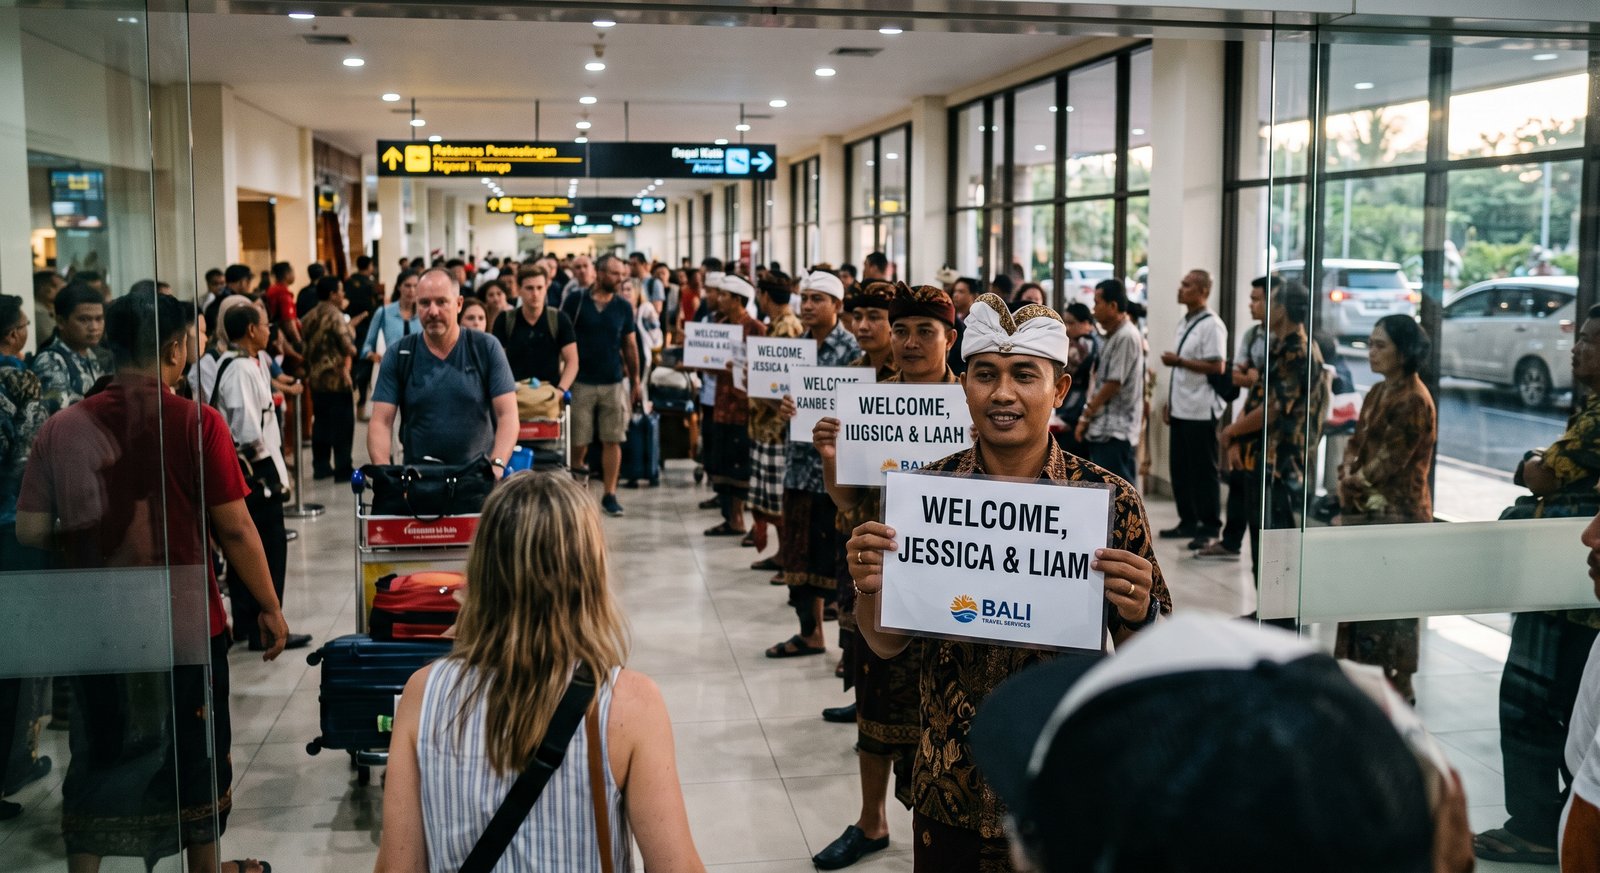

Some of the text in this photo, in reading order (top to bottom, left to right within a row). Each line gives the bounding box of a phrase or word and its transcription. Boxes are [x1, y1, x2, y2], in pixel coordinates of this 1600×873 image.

[752, 361, 782, 373] JESSICA
[859, 396, 950, 419] WELCOME,
[909, 425, 919, 443] &
[922, 495, 1067, 540] WELCOME,
[898, 536, 1089, 580] JESSICA & LIAM
[982, 599, 1031, 621] BALI
[982, 618, 1031, 628] TRAVEL SERVICES
